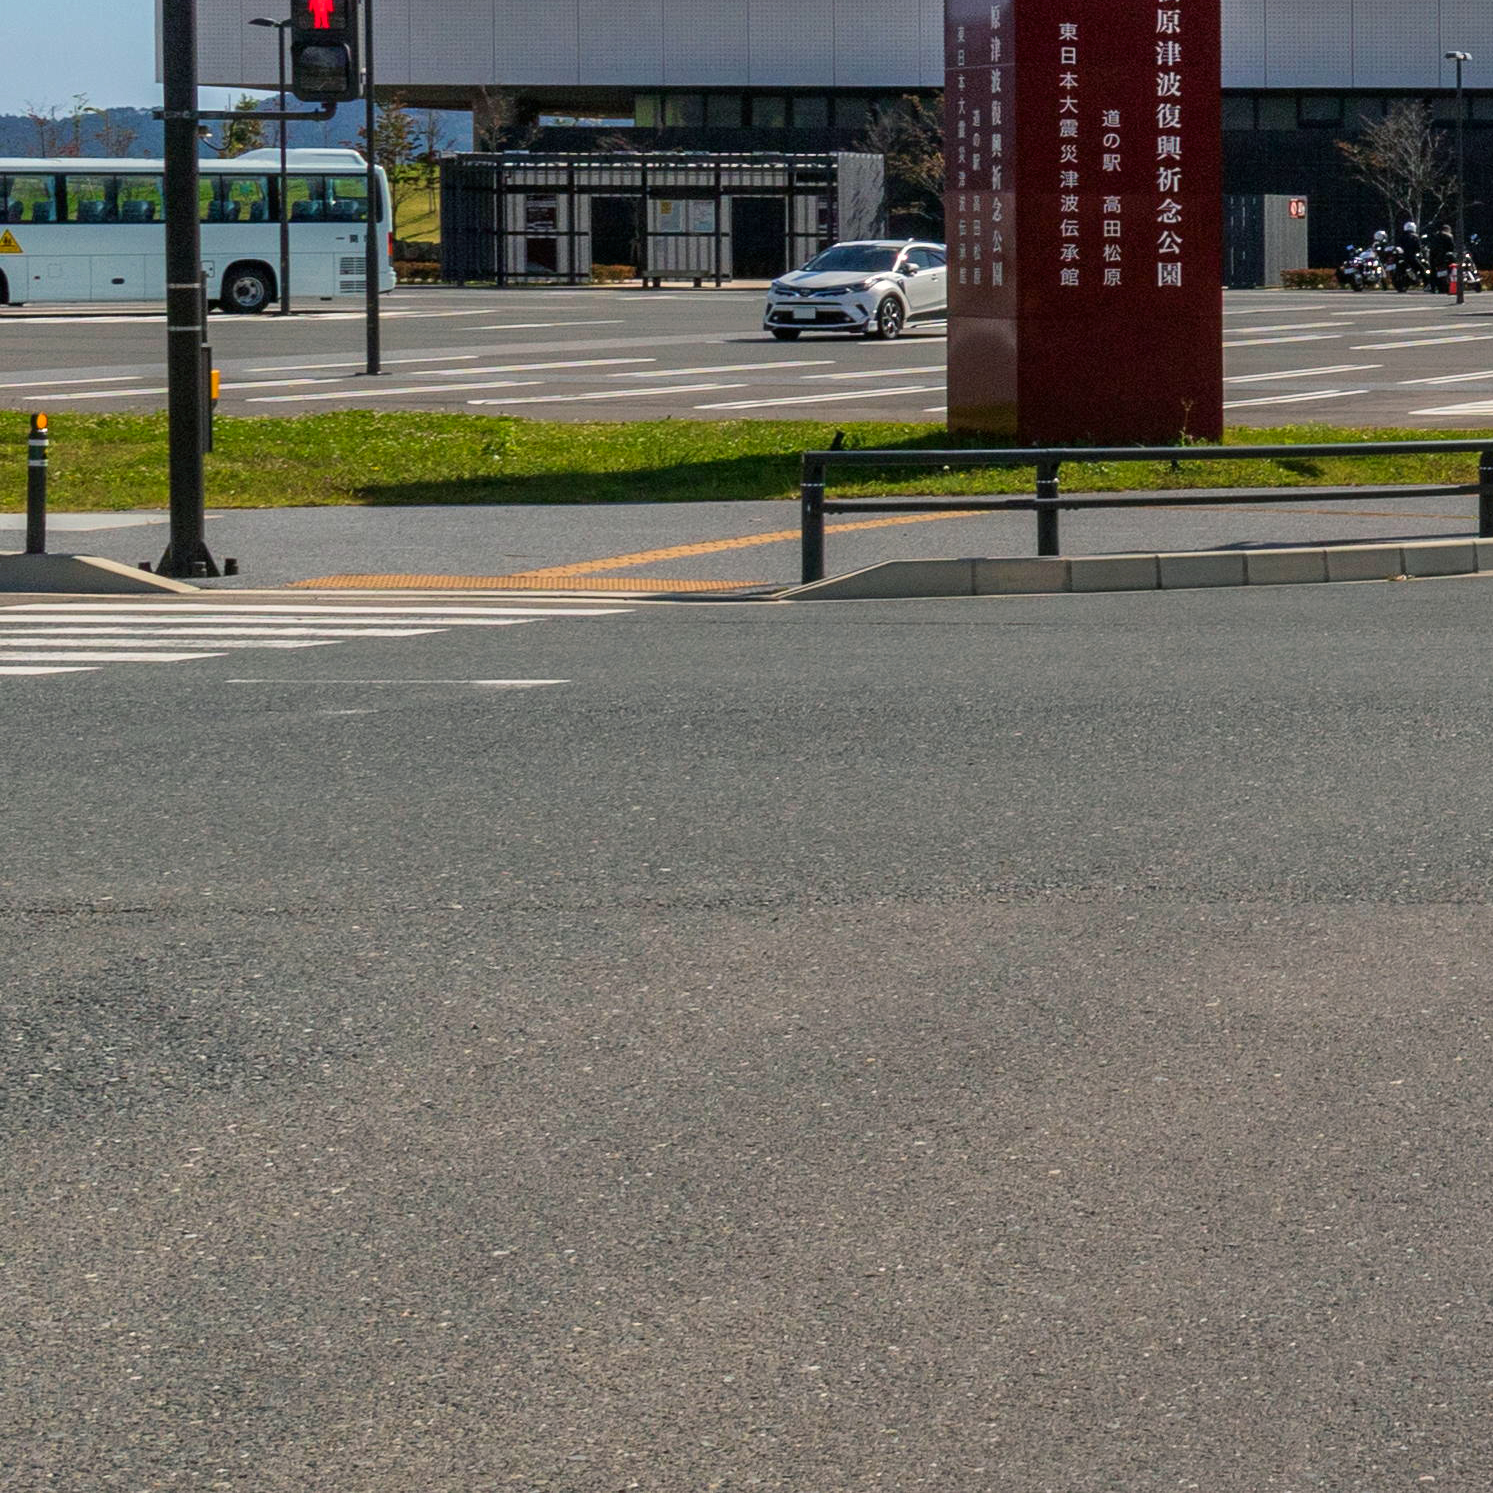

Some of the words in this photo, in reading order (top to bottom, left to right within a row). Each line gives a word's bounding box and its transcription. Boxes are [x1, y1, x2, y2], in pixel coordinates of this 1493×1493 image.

[1058, 22, 1080, 287] 東日本大震災津波伝承館
[1102, 109, 1121, 172] 道の駅
[1103, 195, 1122, 287] 高田松原
